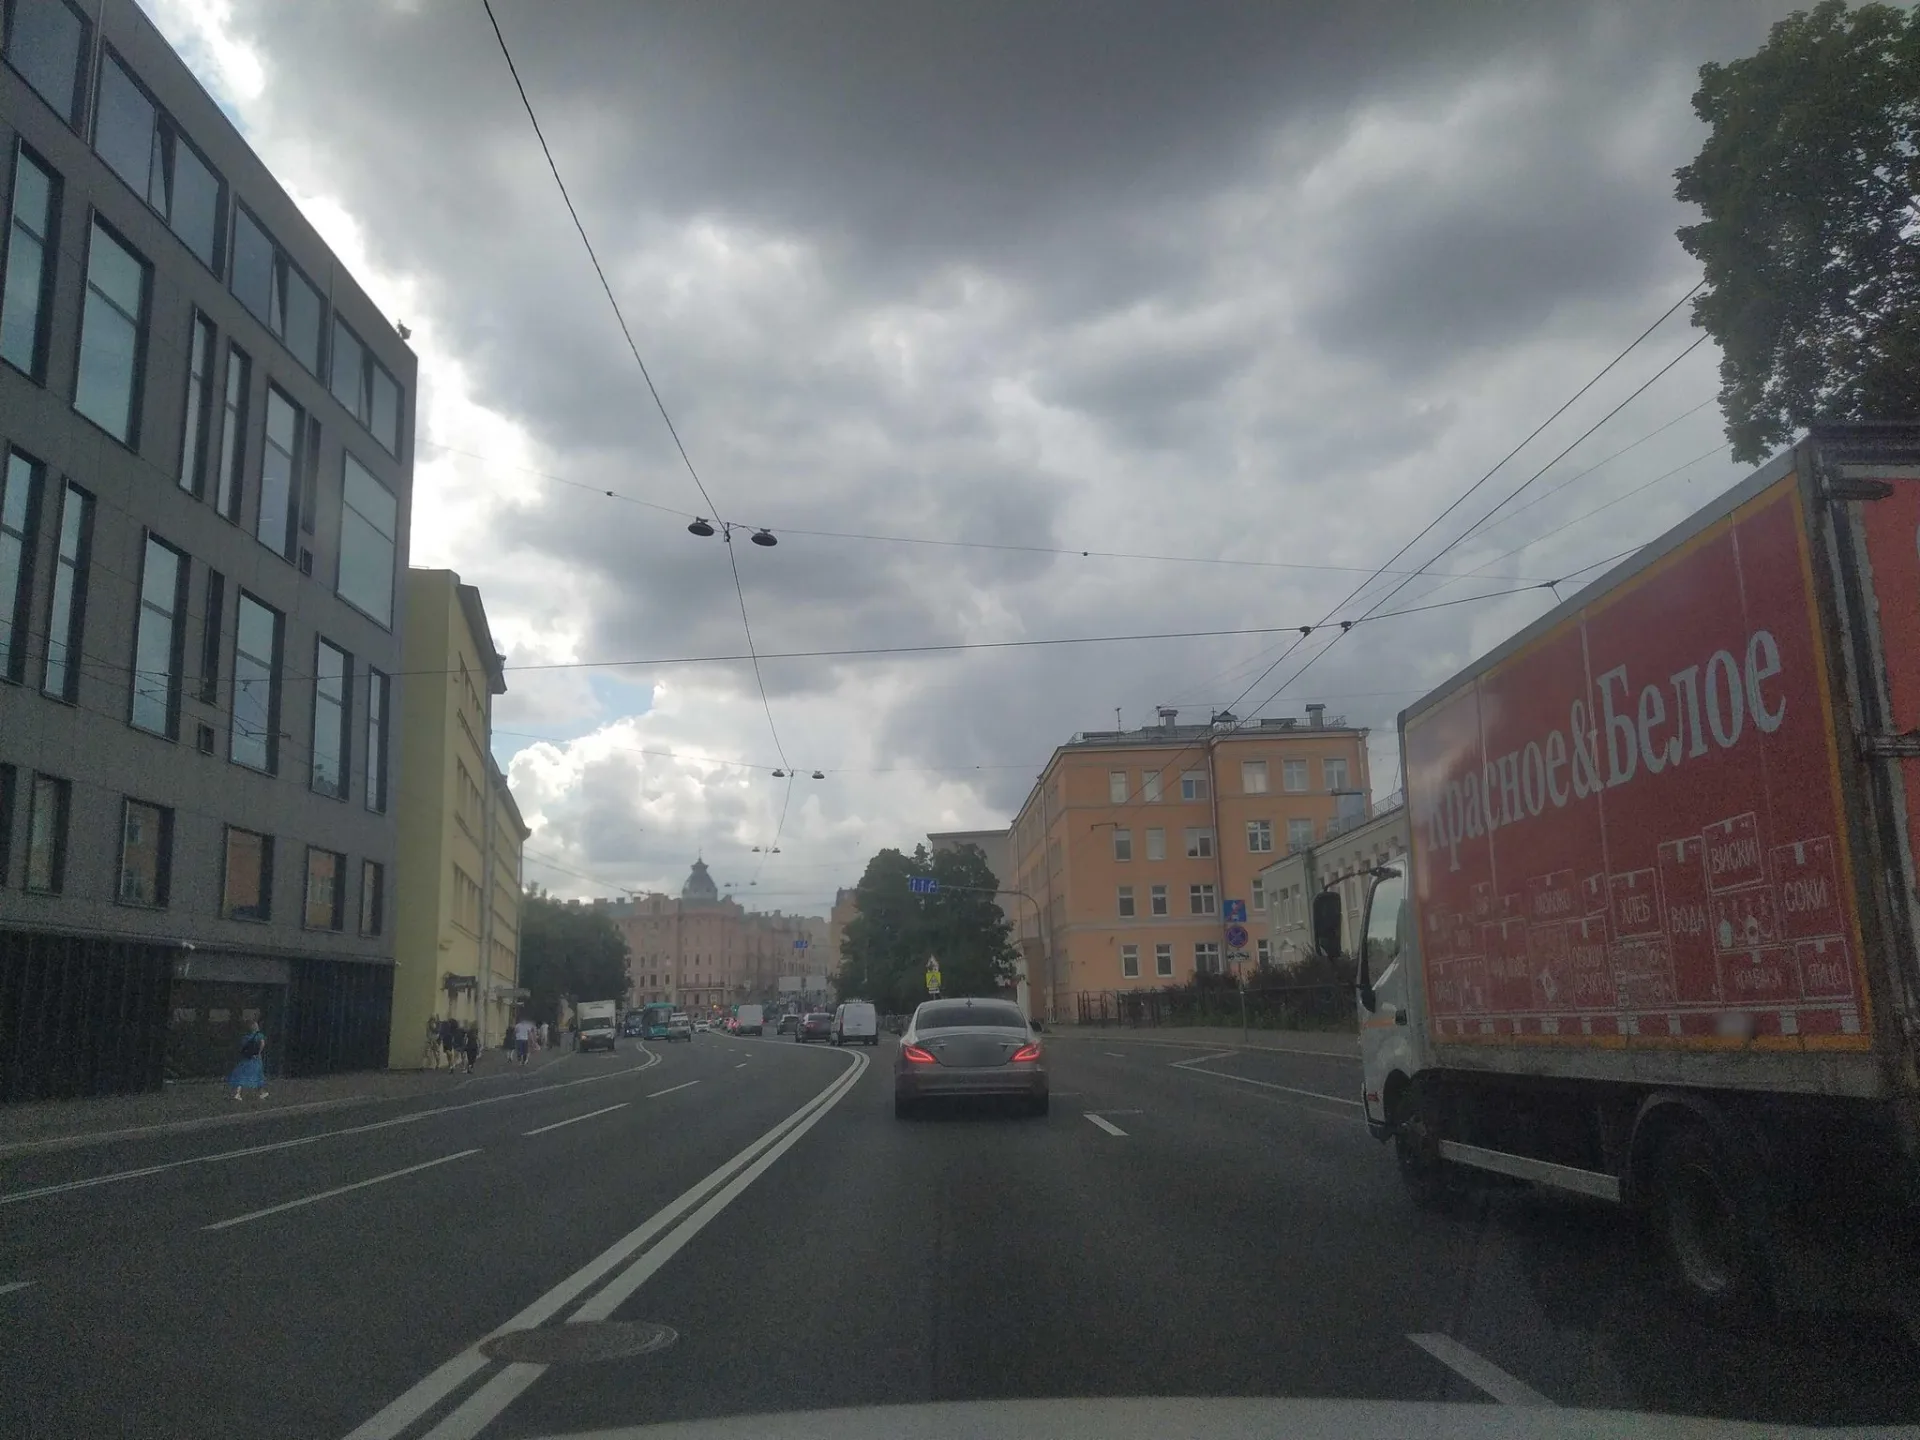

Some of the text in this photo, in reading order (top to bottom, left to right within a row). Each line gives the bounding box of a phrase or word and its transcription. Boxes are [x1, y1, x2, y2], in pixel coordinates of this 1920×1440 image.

[1711, 838, 1757, 873] ВИСКИ
[1620, 895, 1650, 925] ХЛЕБ
[1784, 877, 1827, 912] СОКИ
[1672, 905, 1706, 935] ВОДА
